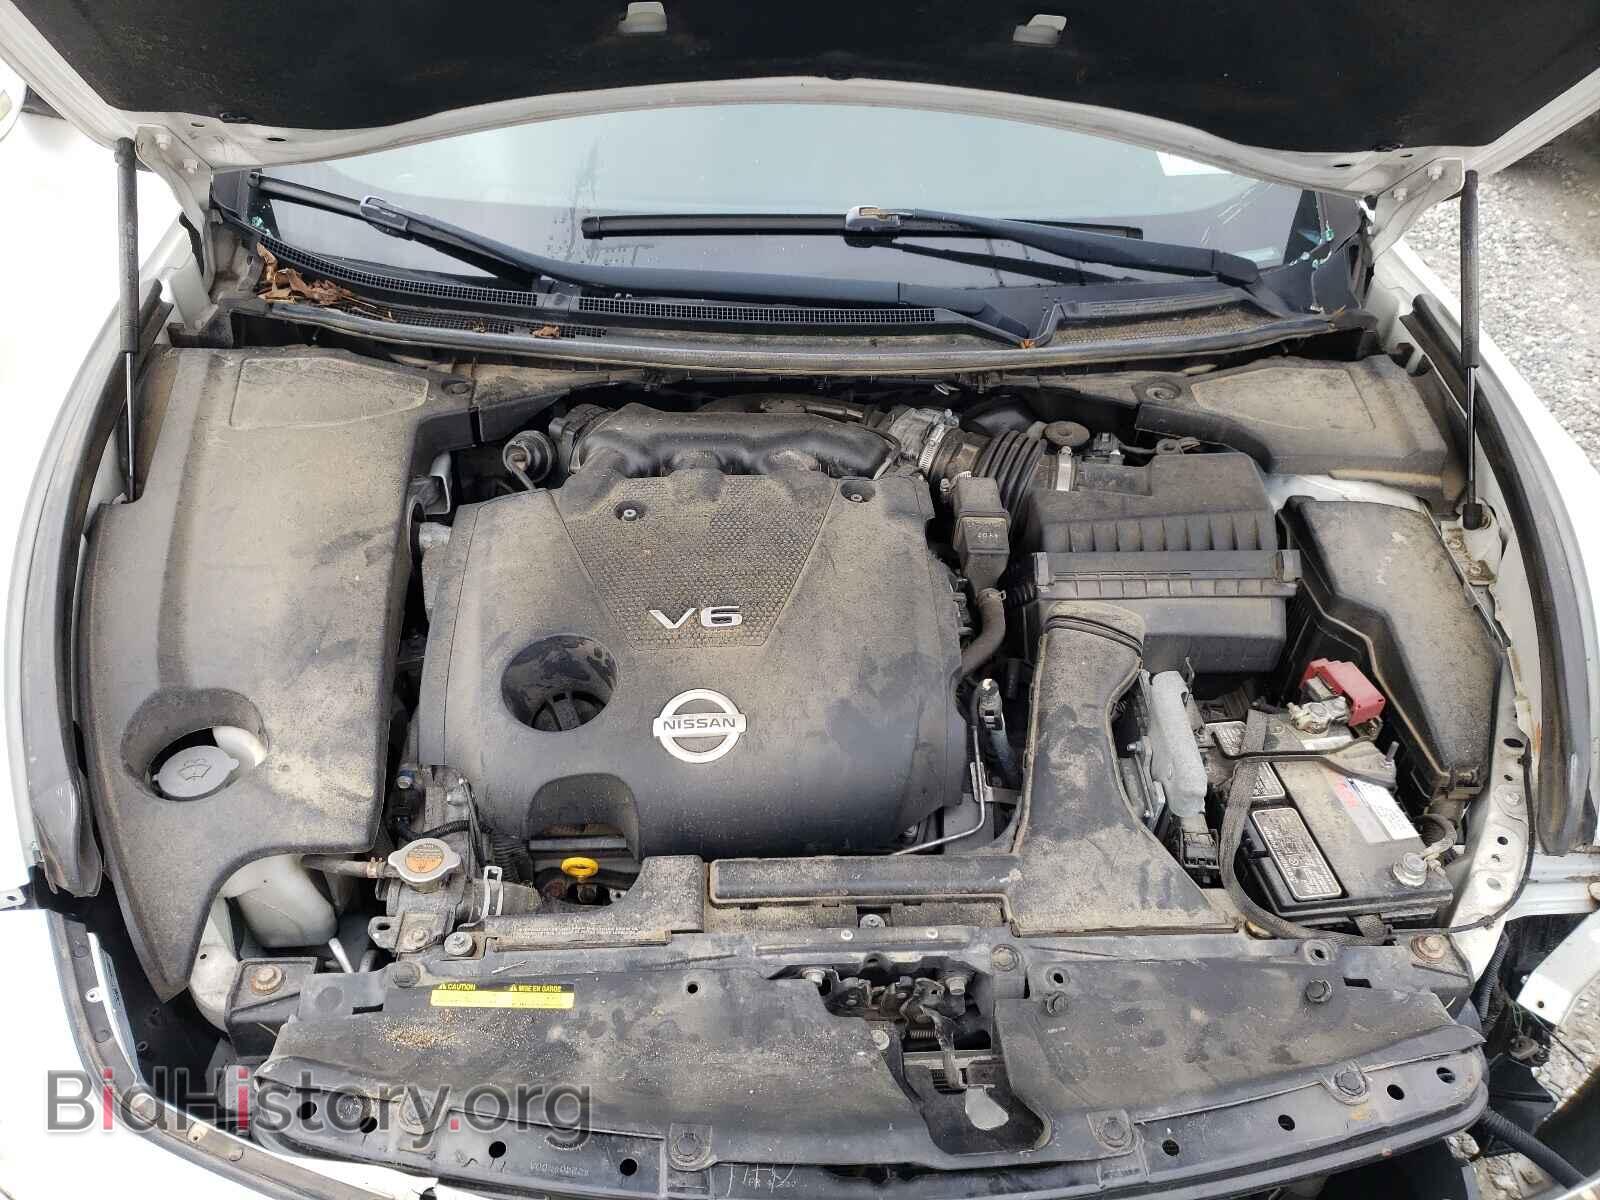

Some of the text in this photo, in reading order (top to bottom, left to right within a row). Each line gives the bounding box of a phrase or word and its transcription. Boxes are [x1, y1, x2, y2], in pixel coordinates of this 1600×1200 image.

[649, 605, 743, 629] V6
[663, 717, 736, 731] NISSAN
[447, 983, 476, 991] CAUTION
